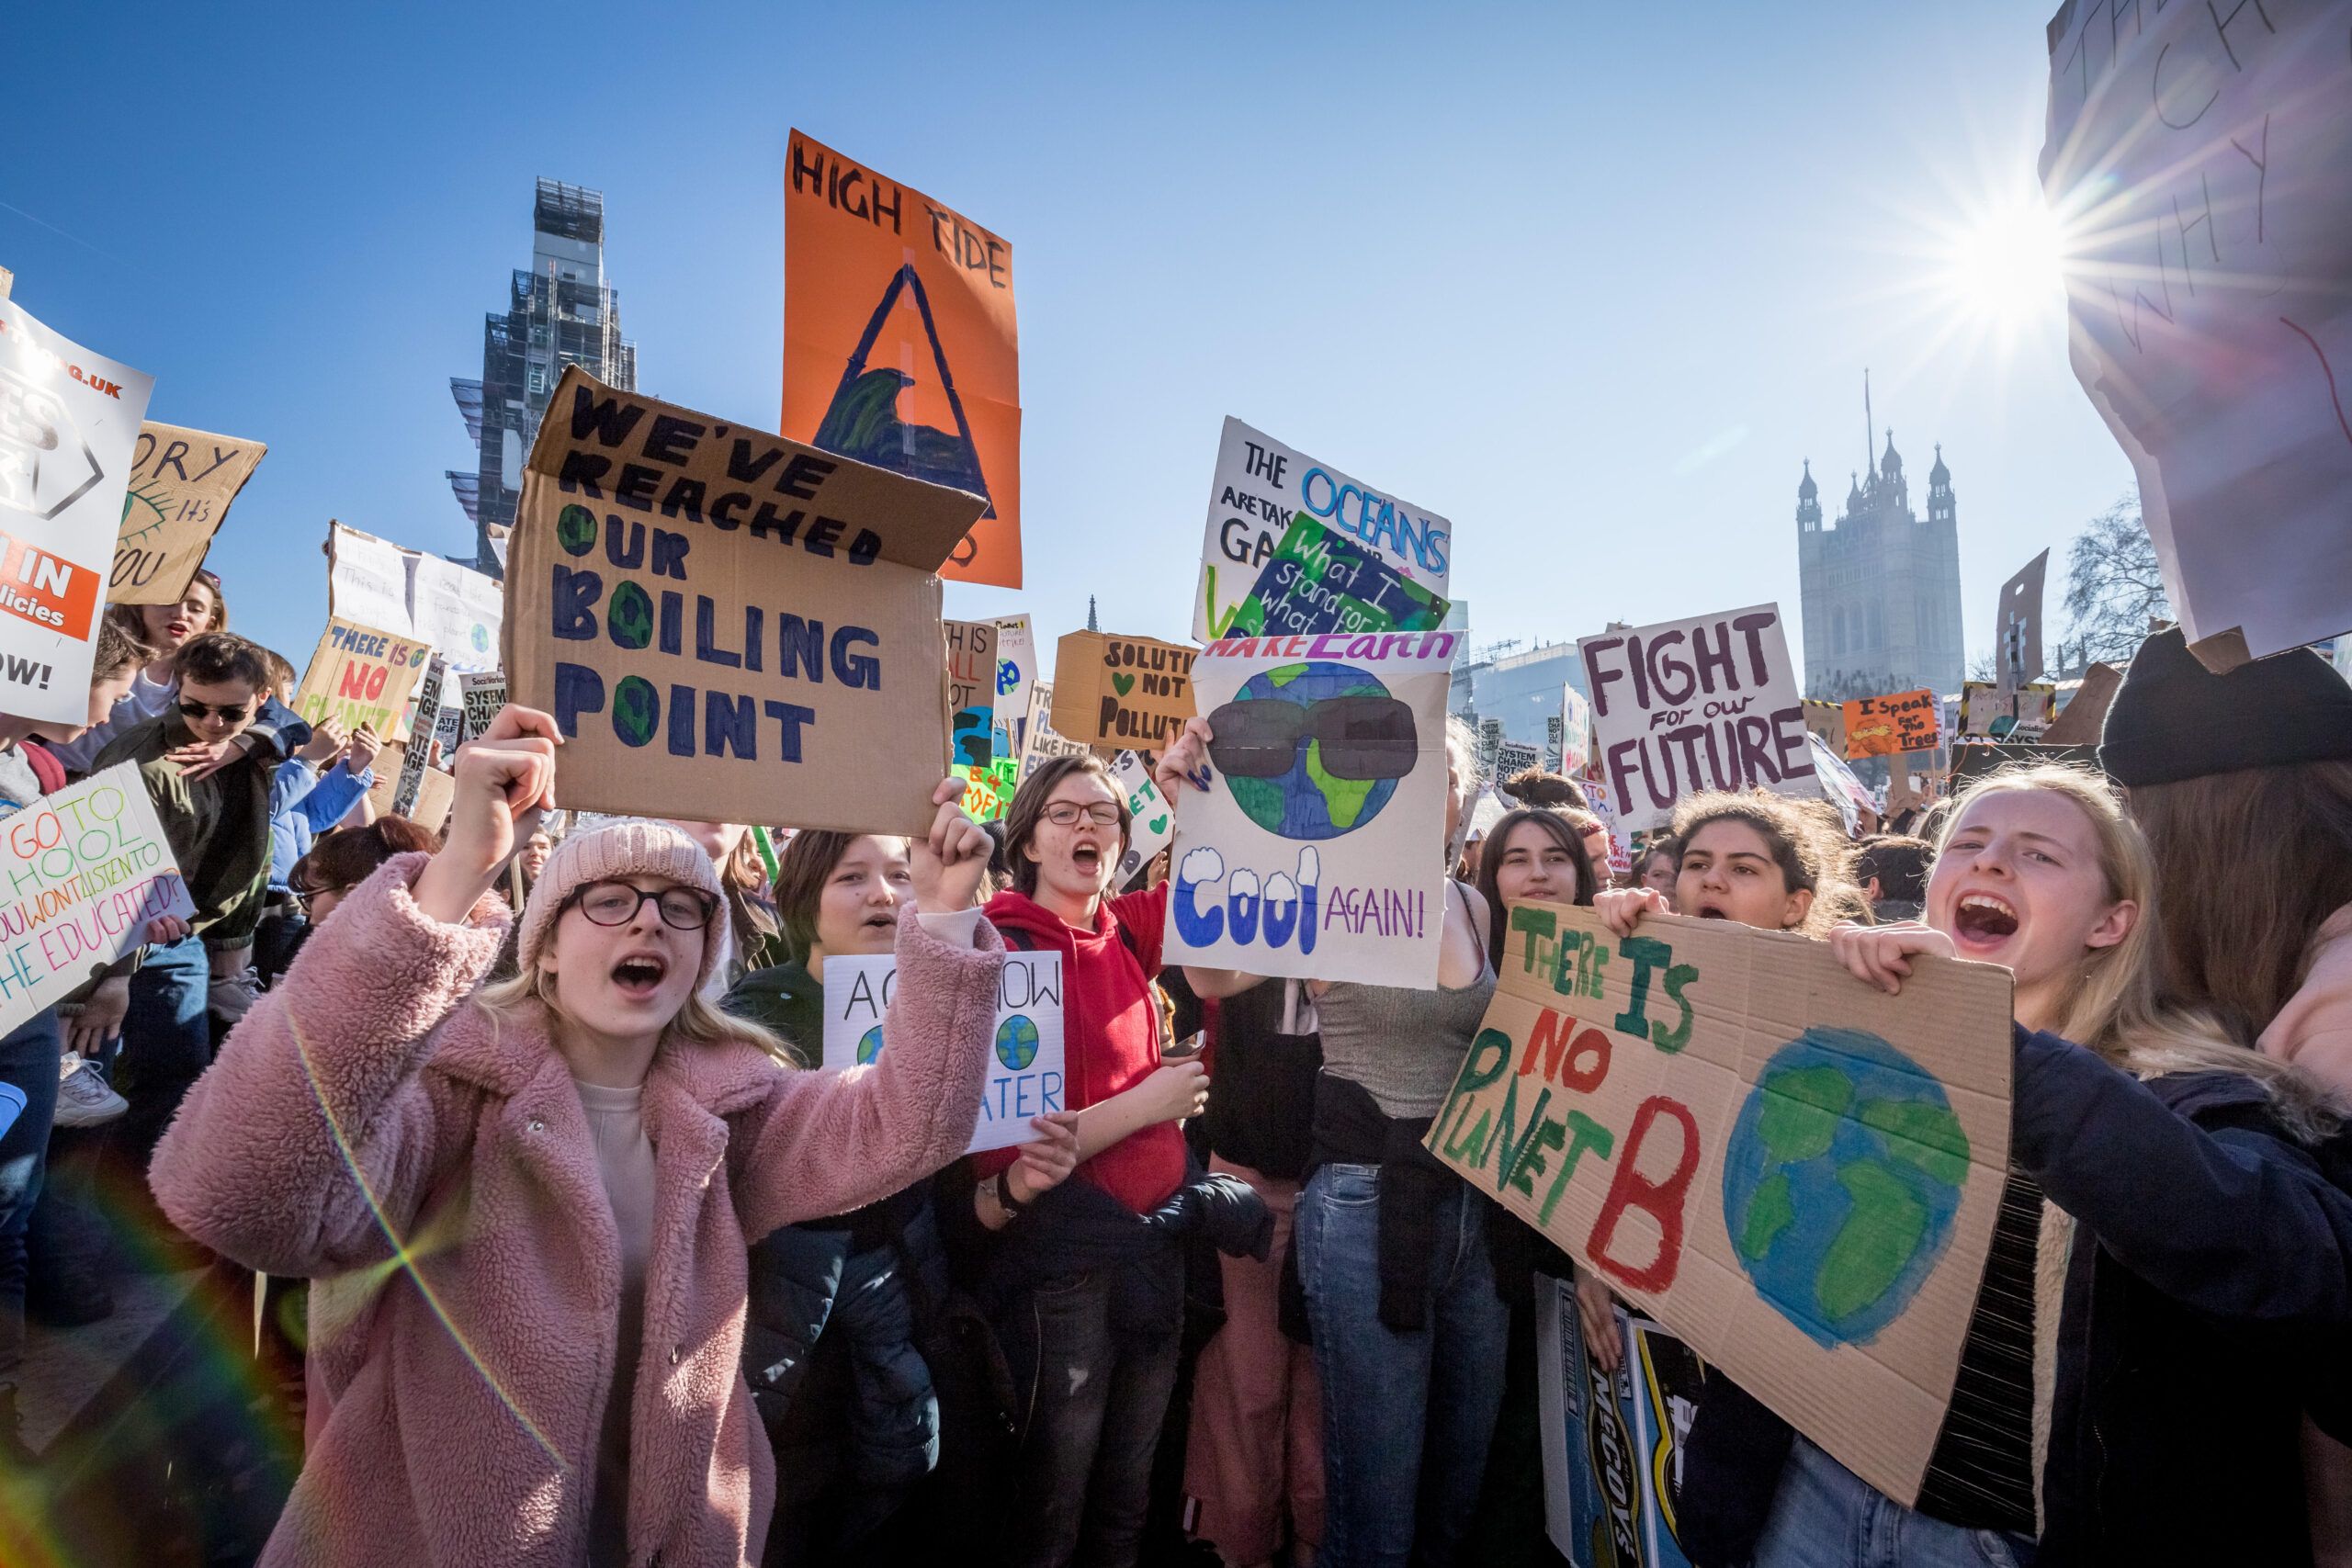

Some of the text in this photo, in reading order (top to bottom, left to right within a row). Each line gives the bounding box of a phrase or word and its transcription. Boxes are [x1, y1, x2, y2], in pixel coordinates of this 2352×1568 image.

[793, 141, 1007, 289] HIGH TIDE
[571, 384, 839, 501] WE'VE
[558, 448, 882, 566] REACHED
[1244, 441, 1451, 579] THE OCEANS
[1258, 500, 1295, 531] TAK
[556, 503, 690, 581] OUR
[1219, 517, 1276, 570] GA
[1292, 528, 1363, 589] What
[1363, 572, 1401, 615] I
[331, 625, 390, 659] THERE
[387, 643, 409, 667] IS
[552, 563, 881, 691] BOILING
[969, 626, 987, 654] IS
[1204, 635, 1308, 660] MAKE
[337, 660, 389, 701] NO
[1103, 641, 1196, 675] SOLUTI
[1583, 612, 1776, 717] FIGHT
[950, 683, 978, 708] OT
[1034, 686, 1052, 709] TR
[1142, 673, 1186, 697] NOT
[1860, 694, 1932, 717] I Speak
[469, 721, 492, 736] NO
[554, 661, 816, 763] POINT
[1099, 695, 1187, 740] POLLUT
[2018, 723, 2046, 733] Socialis
[1032, 735, 1058, 756] LIKE
[1498, 747, 1536, 761] SYSTEM
[1608, 705, 1817, 816] FUTURE
[1896, 732, 1939, 748] Trees
[11, 786, 124, 859] GO TO
[1129, 778, 1156, 816] ET
[7, 818, 142, 897] HOOL
[1172, 844, 1424, 955] Cool AGAIN!
[0, 867, 181, 999] HE EDUCATED?
[997, 960, 1060, 1013] OW
[1511, 904, 1701, 1056] THERE IS
[1518, 1008, 1612, 1094] NO
[1428, 1027, 1702, 1295] PLANET B
